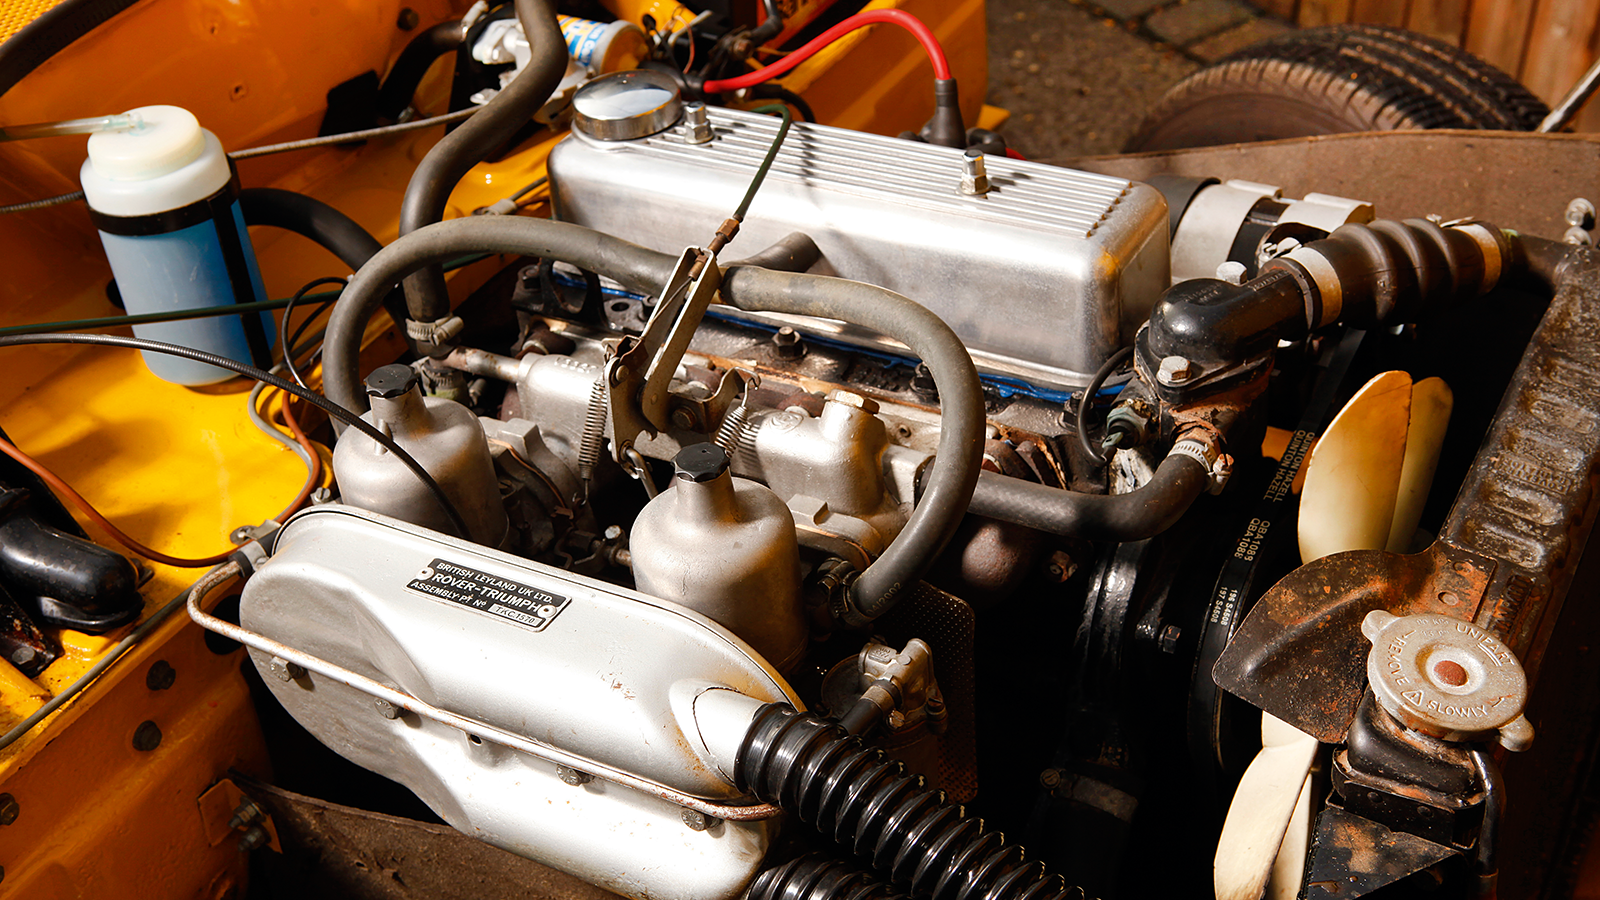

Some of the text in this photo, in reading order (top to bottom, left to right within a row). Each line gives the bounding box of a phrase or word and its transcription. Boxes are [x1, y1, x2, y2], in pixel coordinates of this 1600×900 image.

[1263, 429, 1306, 500] QUINTON HAZELL
[1273, 431, 1315, 502] QUINTON HAZELL
[432, 573, 540, 613] ROVER-TRIUMPH
[437, 562, 553, 604] BRITISH LEYLAND UK LTD.
[1387, 636, 1410, 687] REMOVE
[1456, 622, 1515, 666] UNIPART
[1427, 699, 1489, 718] SLOWLY
